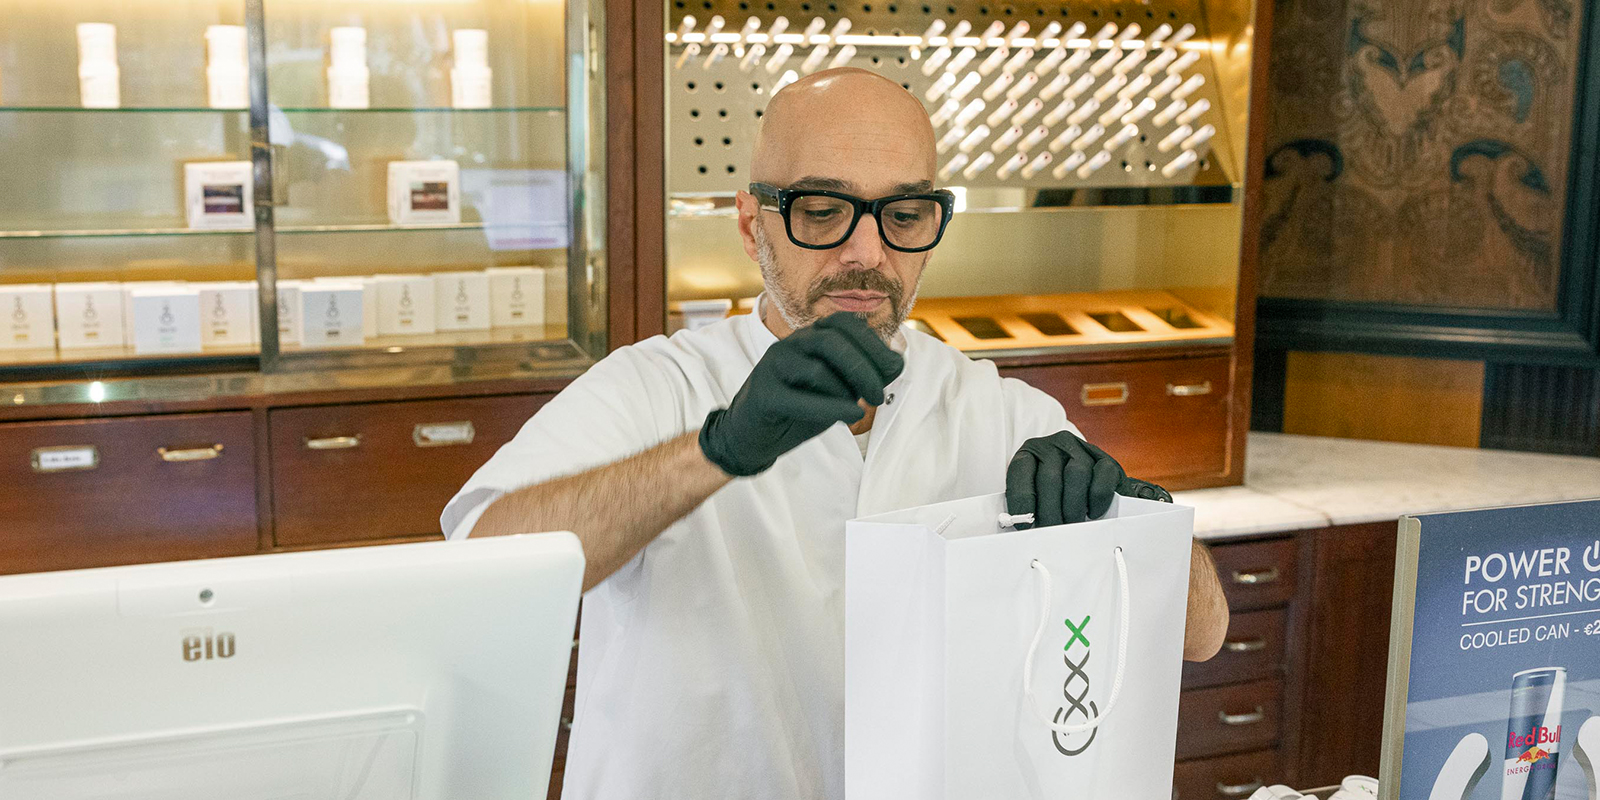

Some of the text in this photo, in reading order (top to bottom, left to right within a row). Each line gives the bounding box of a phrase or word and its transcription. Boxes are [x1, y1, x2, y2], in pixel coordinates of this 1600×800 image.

[1465, 547, 1571, 584] POWER
[1462, 578, 1600, 615] FOR STRENG
[1460, 627, 1531, 650] COOLED
[1535, 623, 1570, 641] CAN
[1508, 724, 1562, 749] Red Bull
